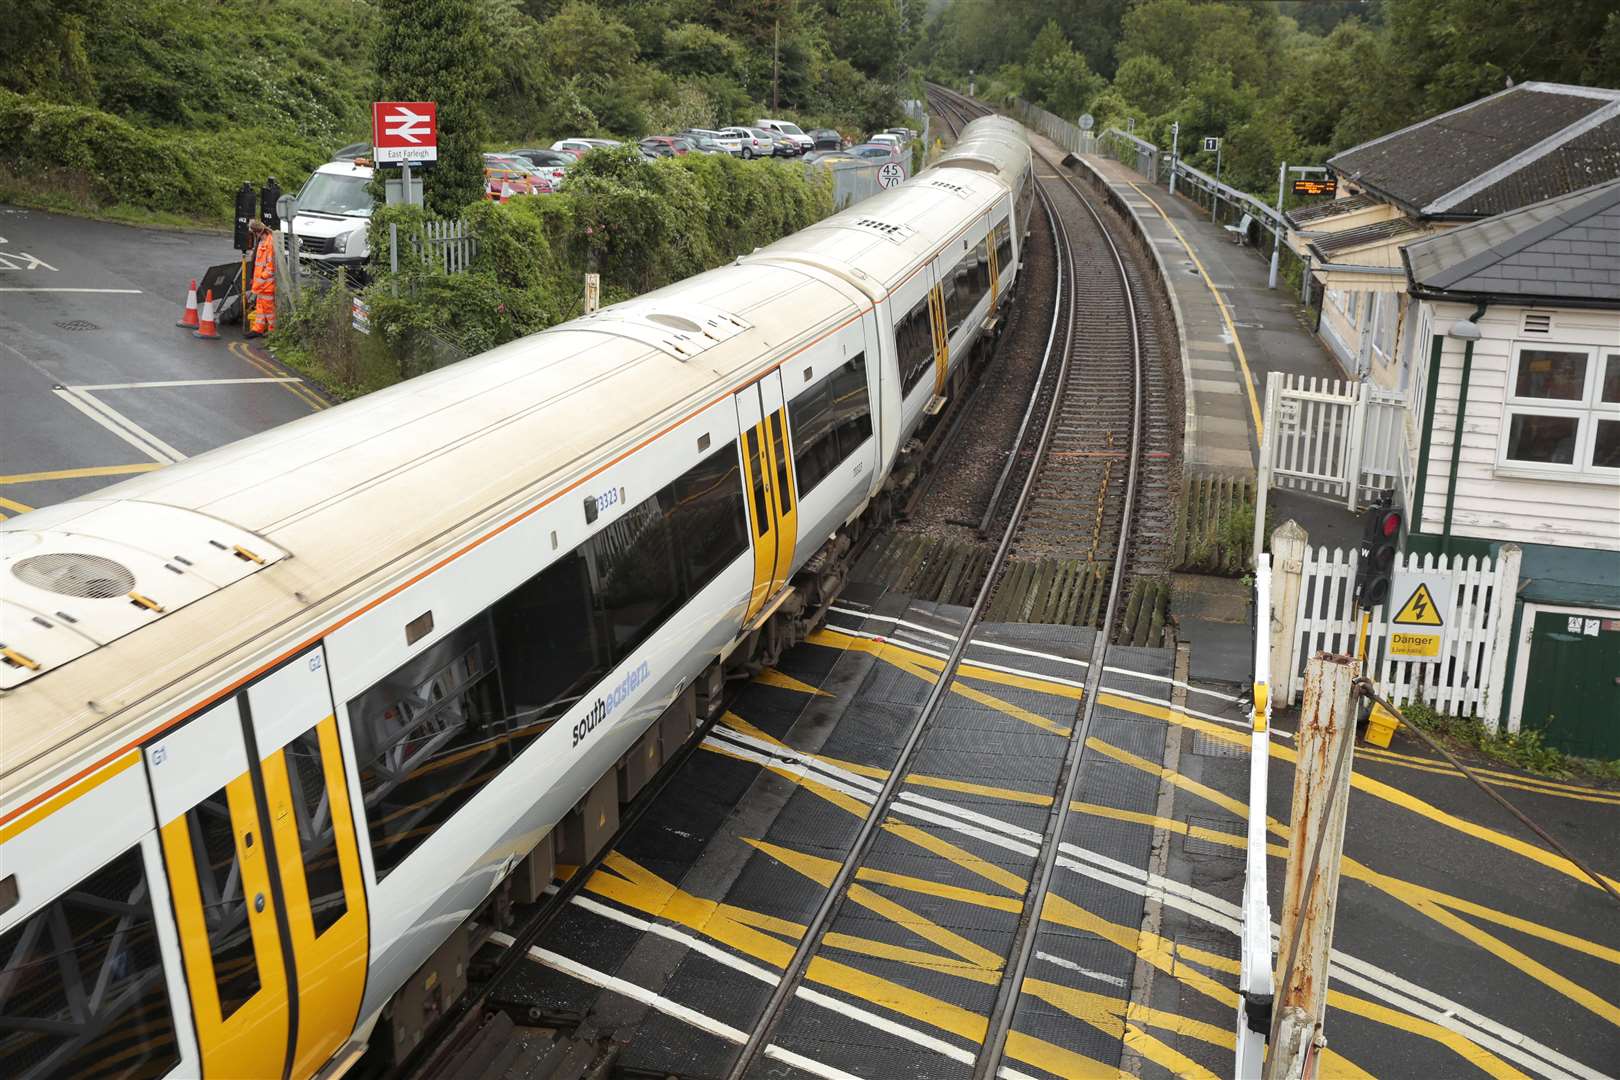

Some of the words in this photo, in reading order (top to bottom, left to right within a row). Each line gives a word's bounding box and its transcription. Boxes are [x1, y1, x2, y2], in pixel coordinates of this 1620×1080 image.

[388, 150, 402, 158] East
[403, 150, 430, 159] Farleigh
[883, 165, 898, 176] 45
[884, 177, 899, 188] 70
[1392, 634, 1433, 646] Danger
